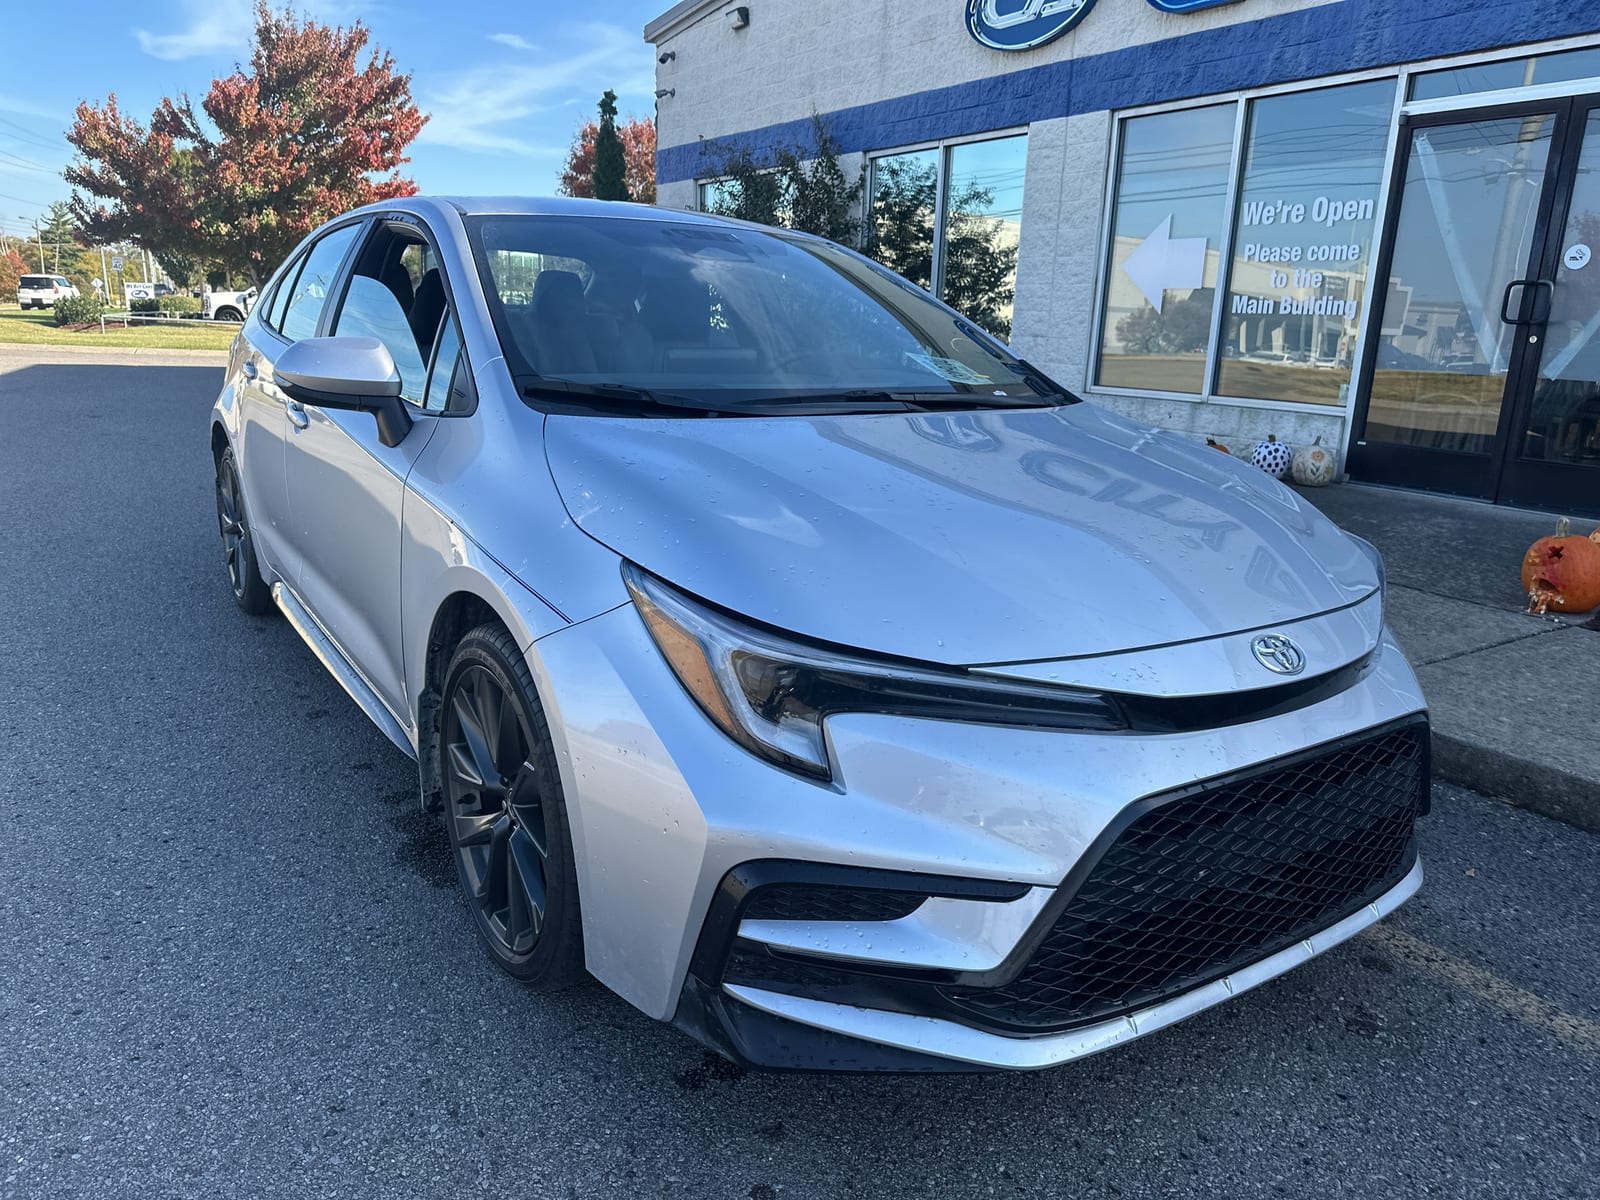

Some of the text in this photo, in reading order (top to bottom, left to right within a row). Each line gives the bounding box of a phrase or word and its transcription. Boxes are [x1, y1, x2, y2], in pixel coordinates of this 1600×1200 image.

[1243, 196, 1374, 227] We're Open
[1243, 243, 1360, 262] Please come
[1269, 268, 1323, 288] to the
[1231, 295, 1357, 321] Main Building
